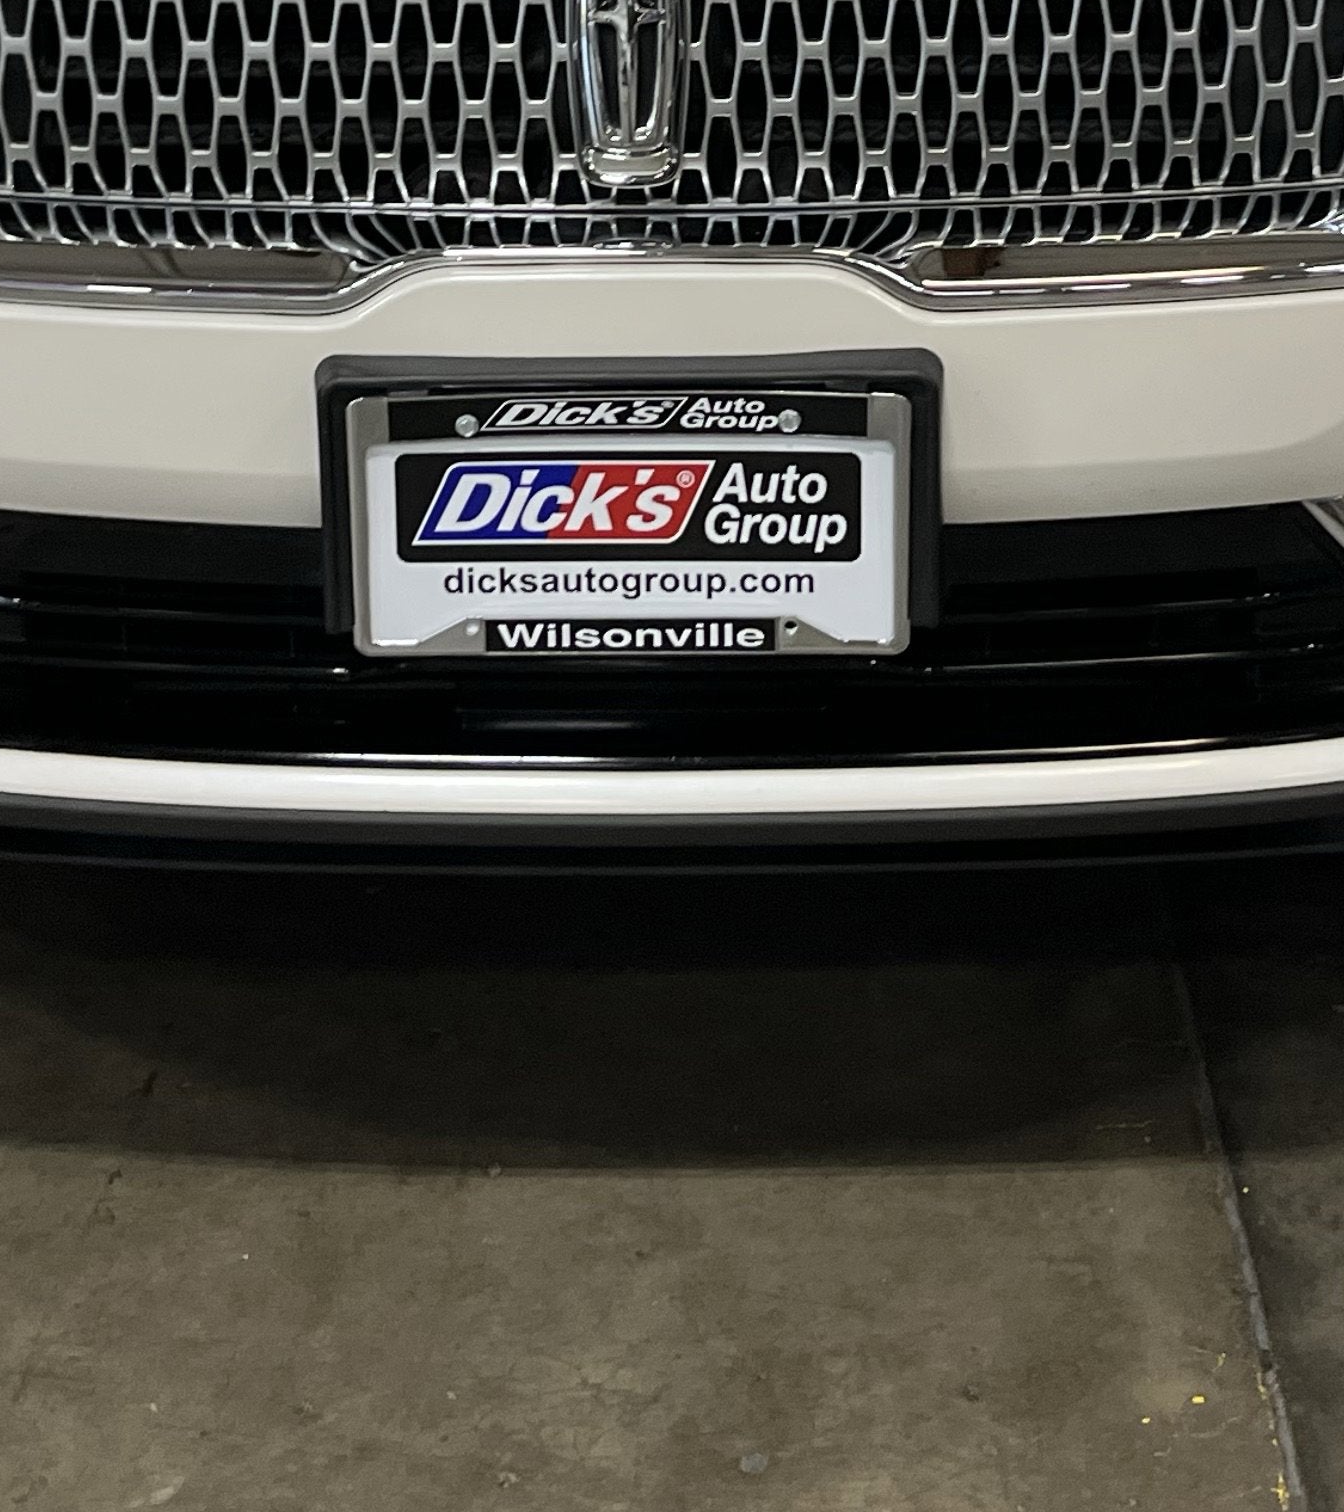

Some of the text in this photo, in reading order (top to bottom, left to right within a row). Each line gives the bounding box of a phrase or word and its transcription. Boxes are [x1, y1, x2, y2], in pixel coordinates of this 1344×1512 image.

[495, 400, 665, 427] Dick's
[688, 397, 765, 414] Auto
[680, 412, 779, 432] Group
[713, 462, 828, 504] Auto
[434, 468, 680, 533] Dick's
[704, 504, 848, 553] Group
[443, 567, 815, 600] dicksautogroup.com
[497, 622, 766, 649] Wilsonville
